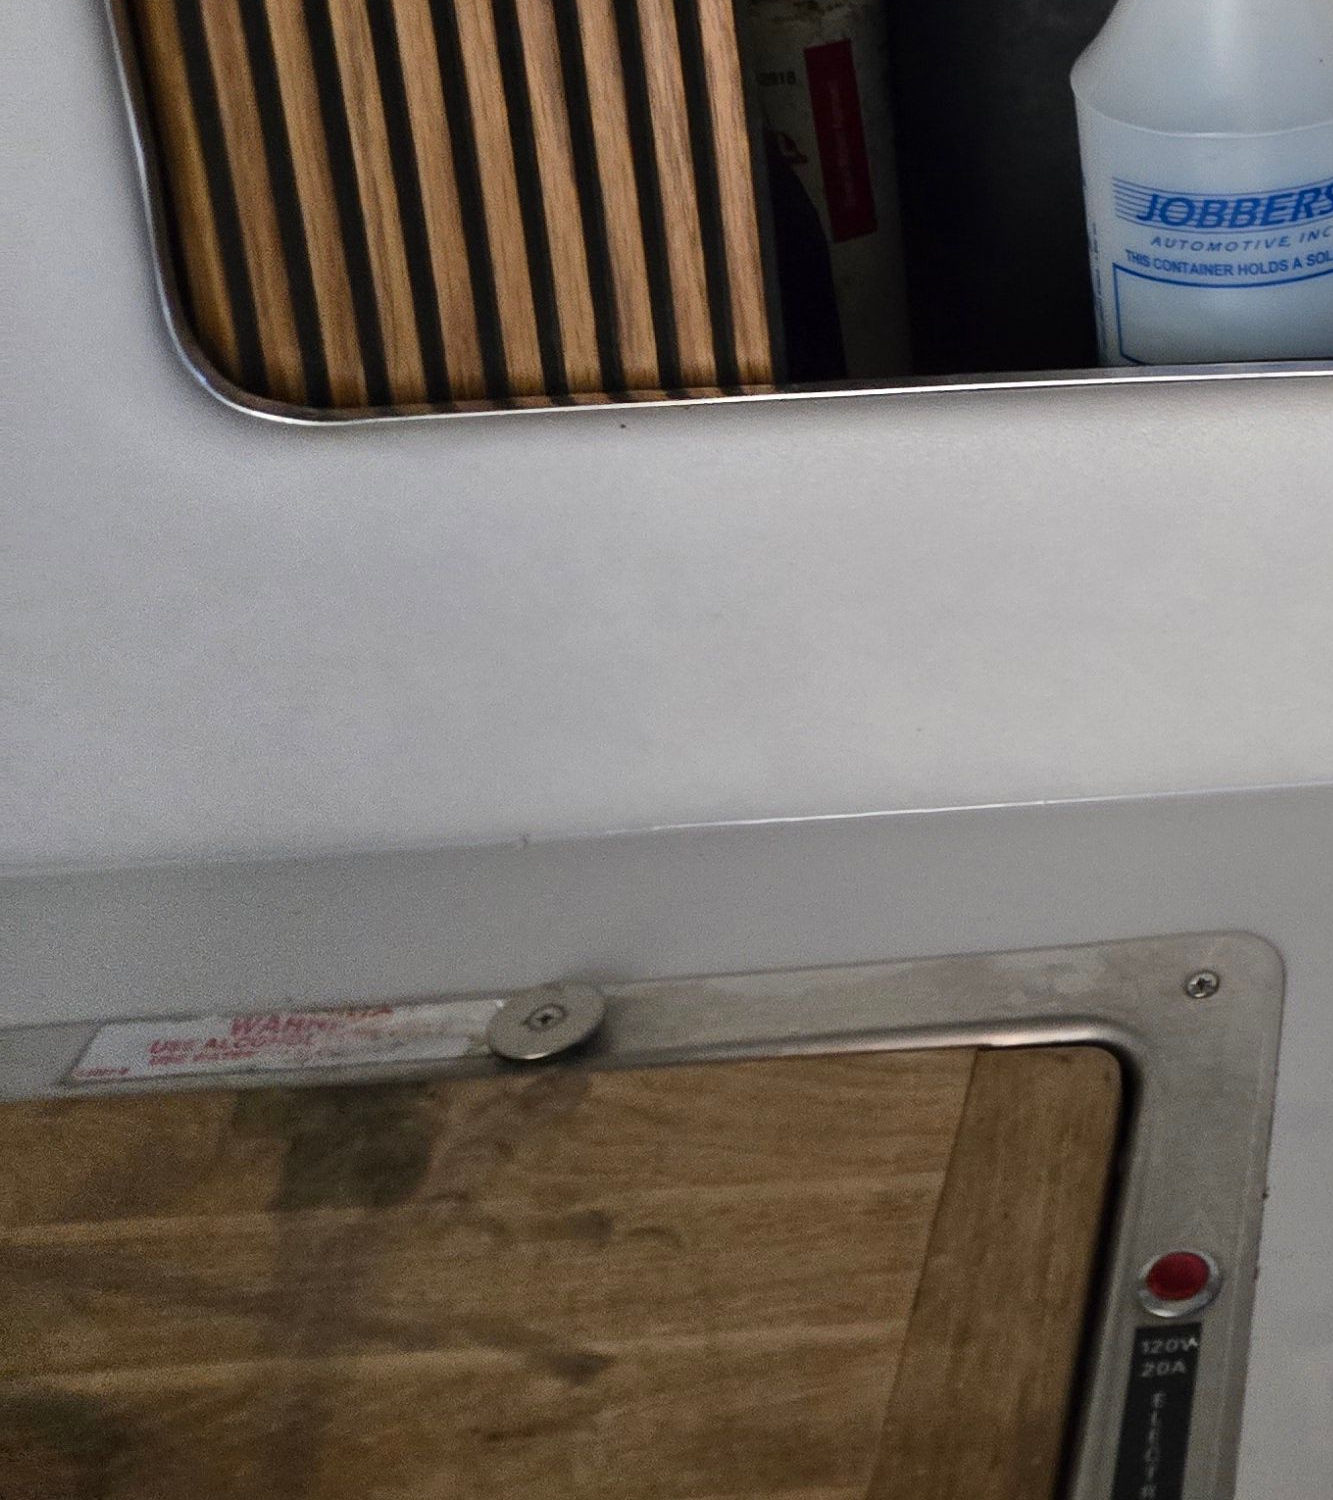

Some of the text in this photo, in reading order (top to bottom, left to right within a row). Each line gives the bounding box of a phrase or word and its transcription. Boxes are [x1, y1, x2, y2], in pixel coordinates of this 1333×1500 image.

[1150, 226, 1333, 252] AUTOMOTIVE INC
[1126, 250, 1150, 268] THIS
[1153, 258, 1234, 276] CONTAINER
[1238, 256, 1289, 276] HOLDS
[1292, 258, 1303, 270] A
[1142, 1360, 1187, 1377] 20A
